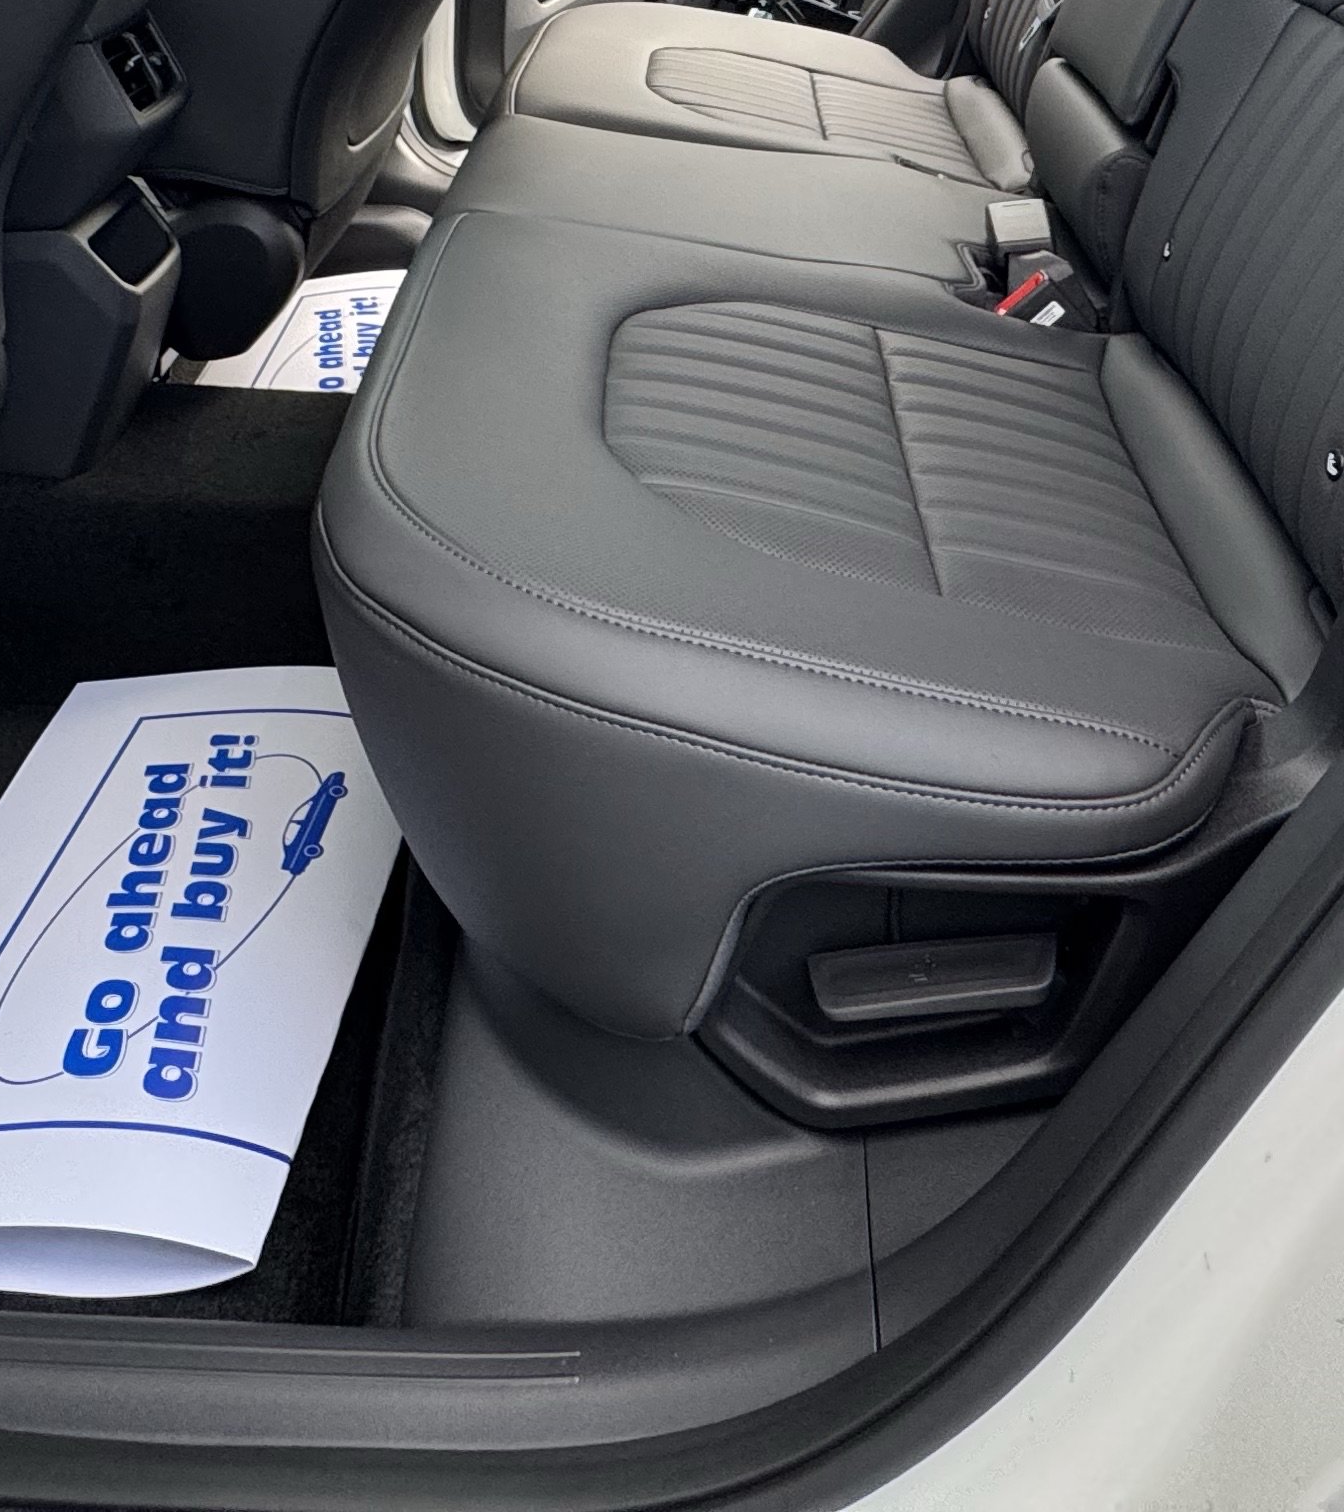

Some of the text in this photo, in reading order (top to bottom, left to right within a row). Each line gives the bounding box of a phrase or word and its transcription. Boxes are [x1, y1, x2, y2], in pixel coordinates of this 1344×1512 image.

[349, 296, 379, 315] it!
[314, 309, 343, 369] ahead
[352, 323, 383, 357] buy
[62, 762, 194, 1079] Go ahead
[142, 733, 260, 1103] and buy it!
